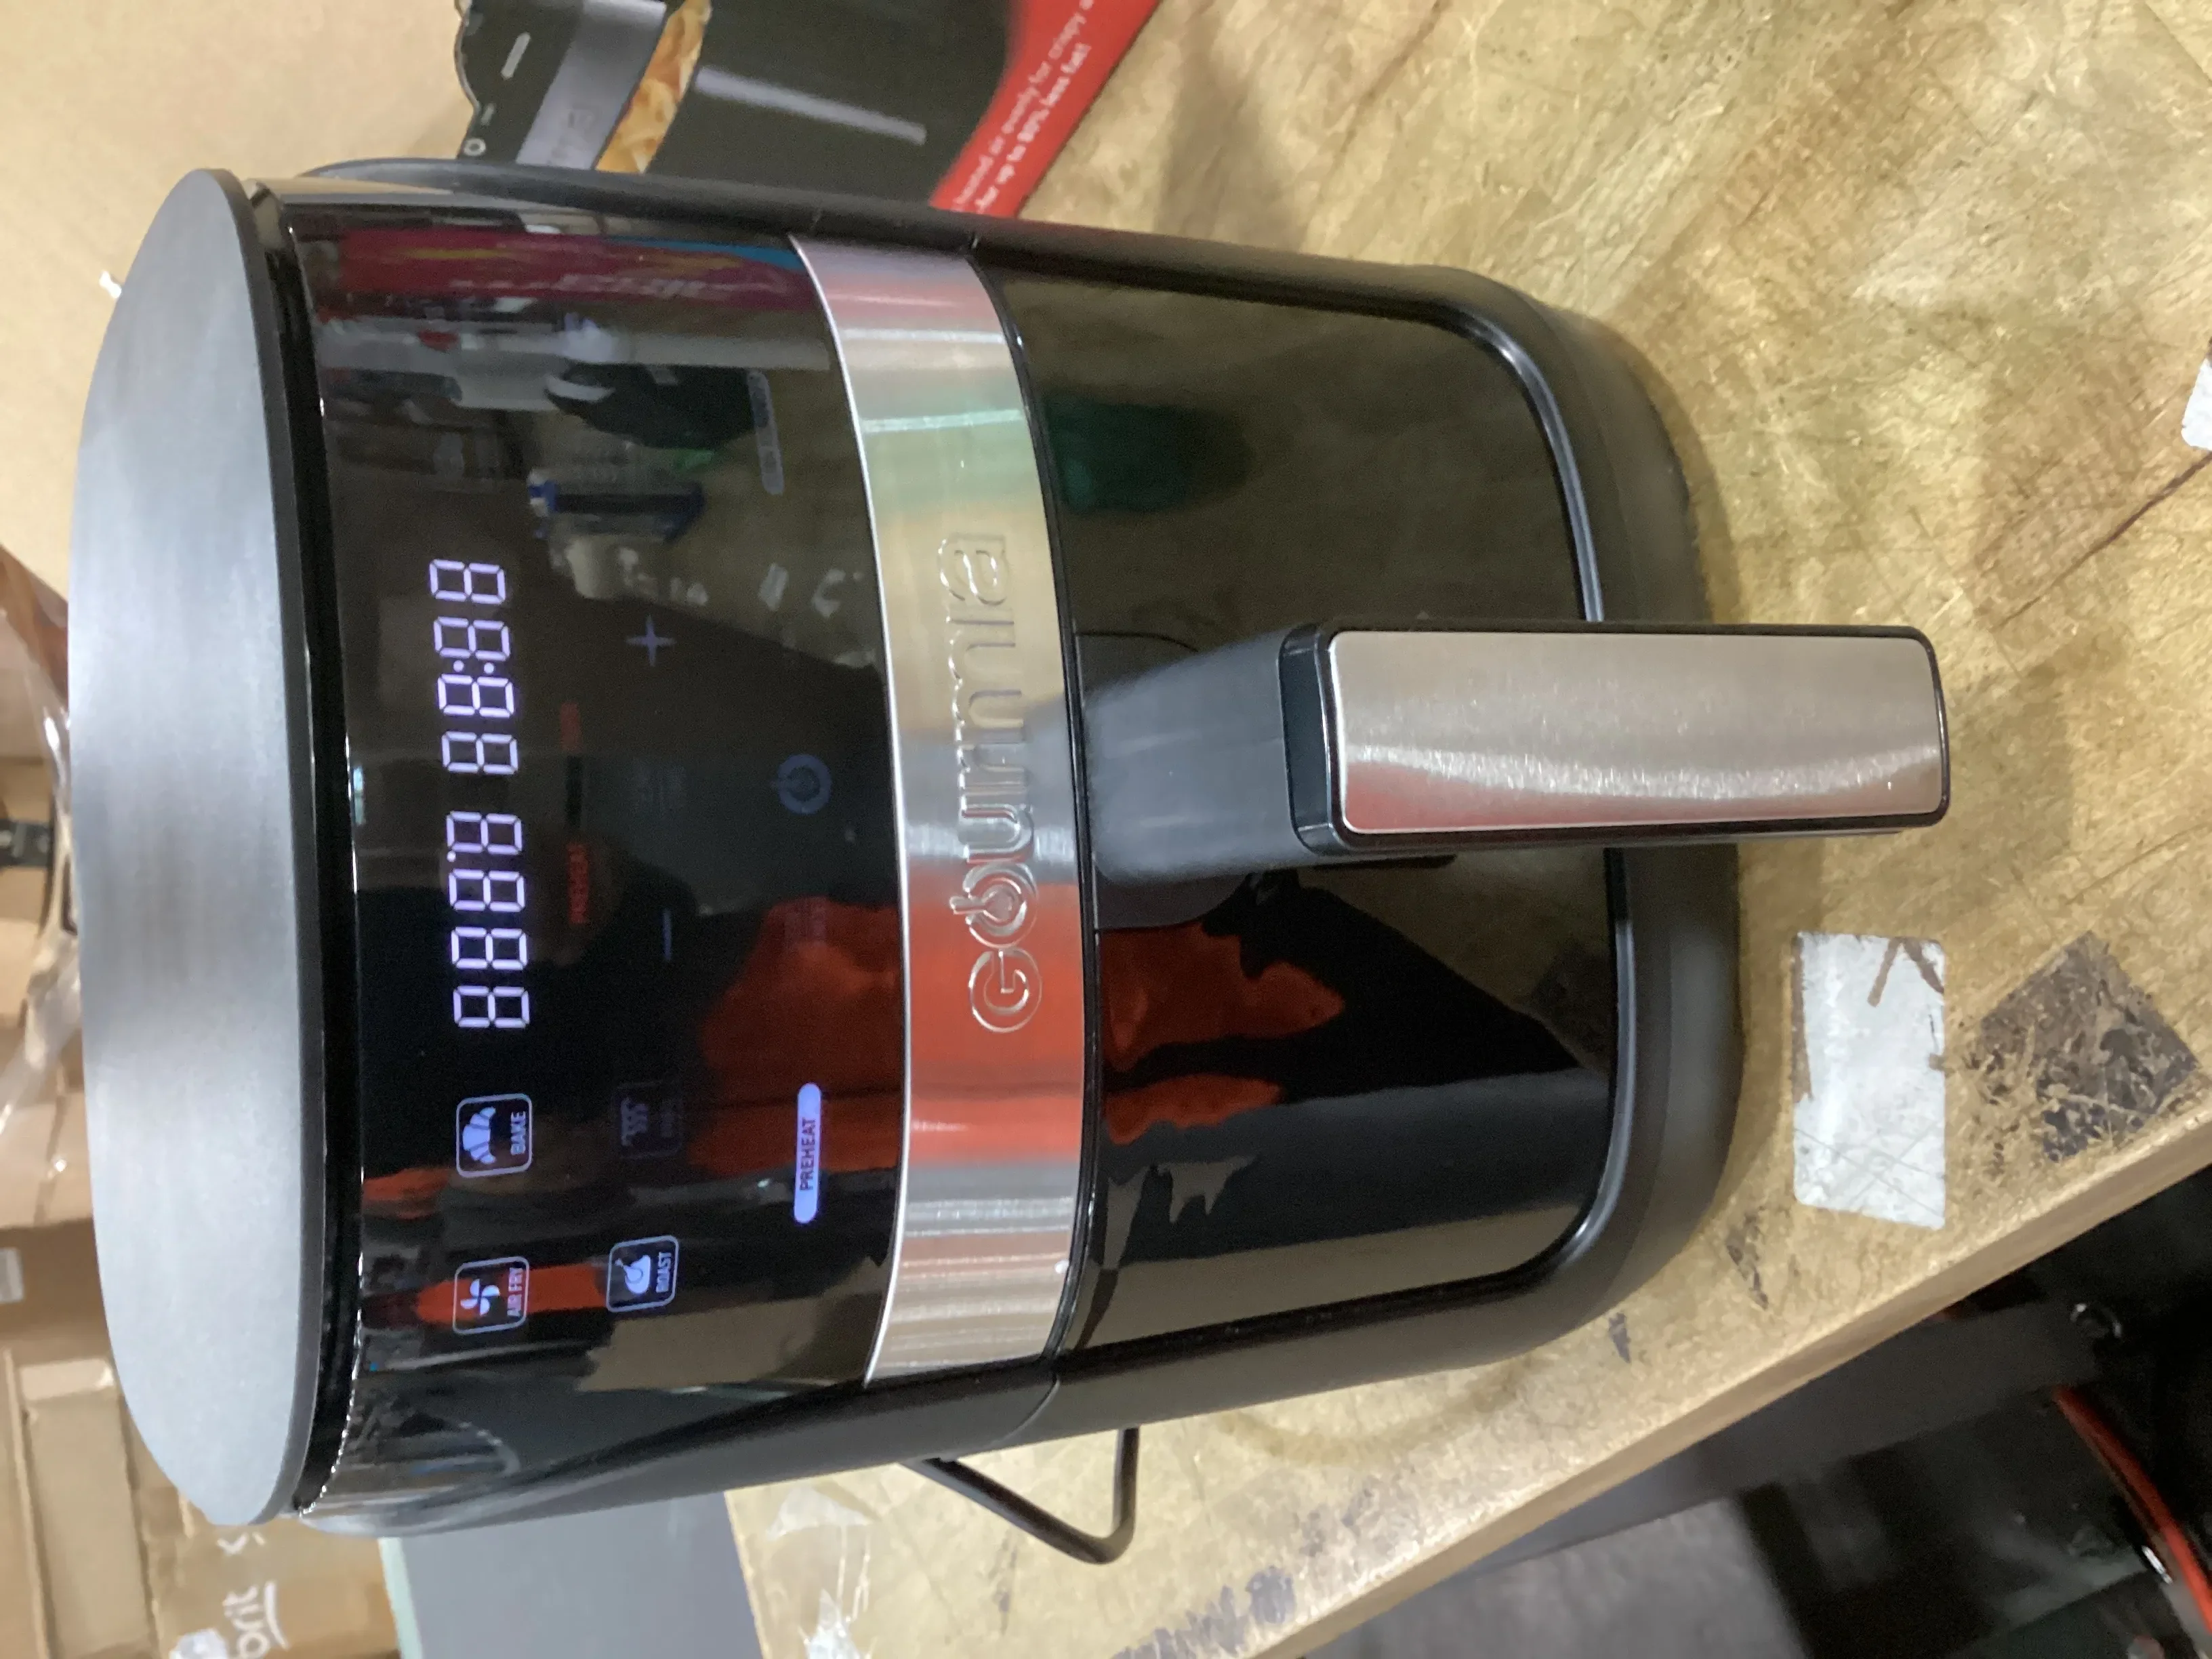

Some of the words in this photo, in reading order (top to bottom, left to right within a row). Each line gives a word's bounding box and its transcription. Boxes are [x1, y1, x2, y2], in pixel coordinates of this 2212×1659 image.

[938, 533, 1042, 1032] Gourmia
[510, 1110, 527, 1155] BAKE
[799, 1116, 816, 1191] PREHEAT
[508, 1267, 523, 1290] FRY
[655, 1250, 672, 1292] ROAST
[507, 1292, 522, 1317] AIR
